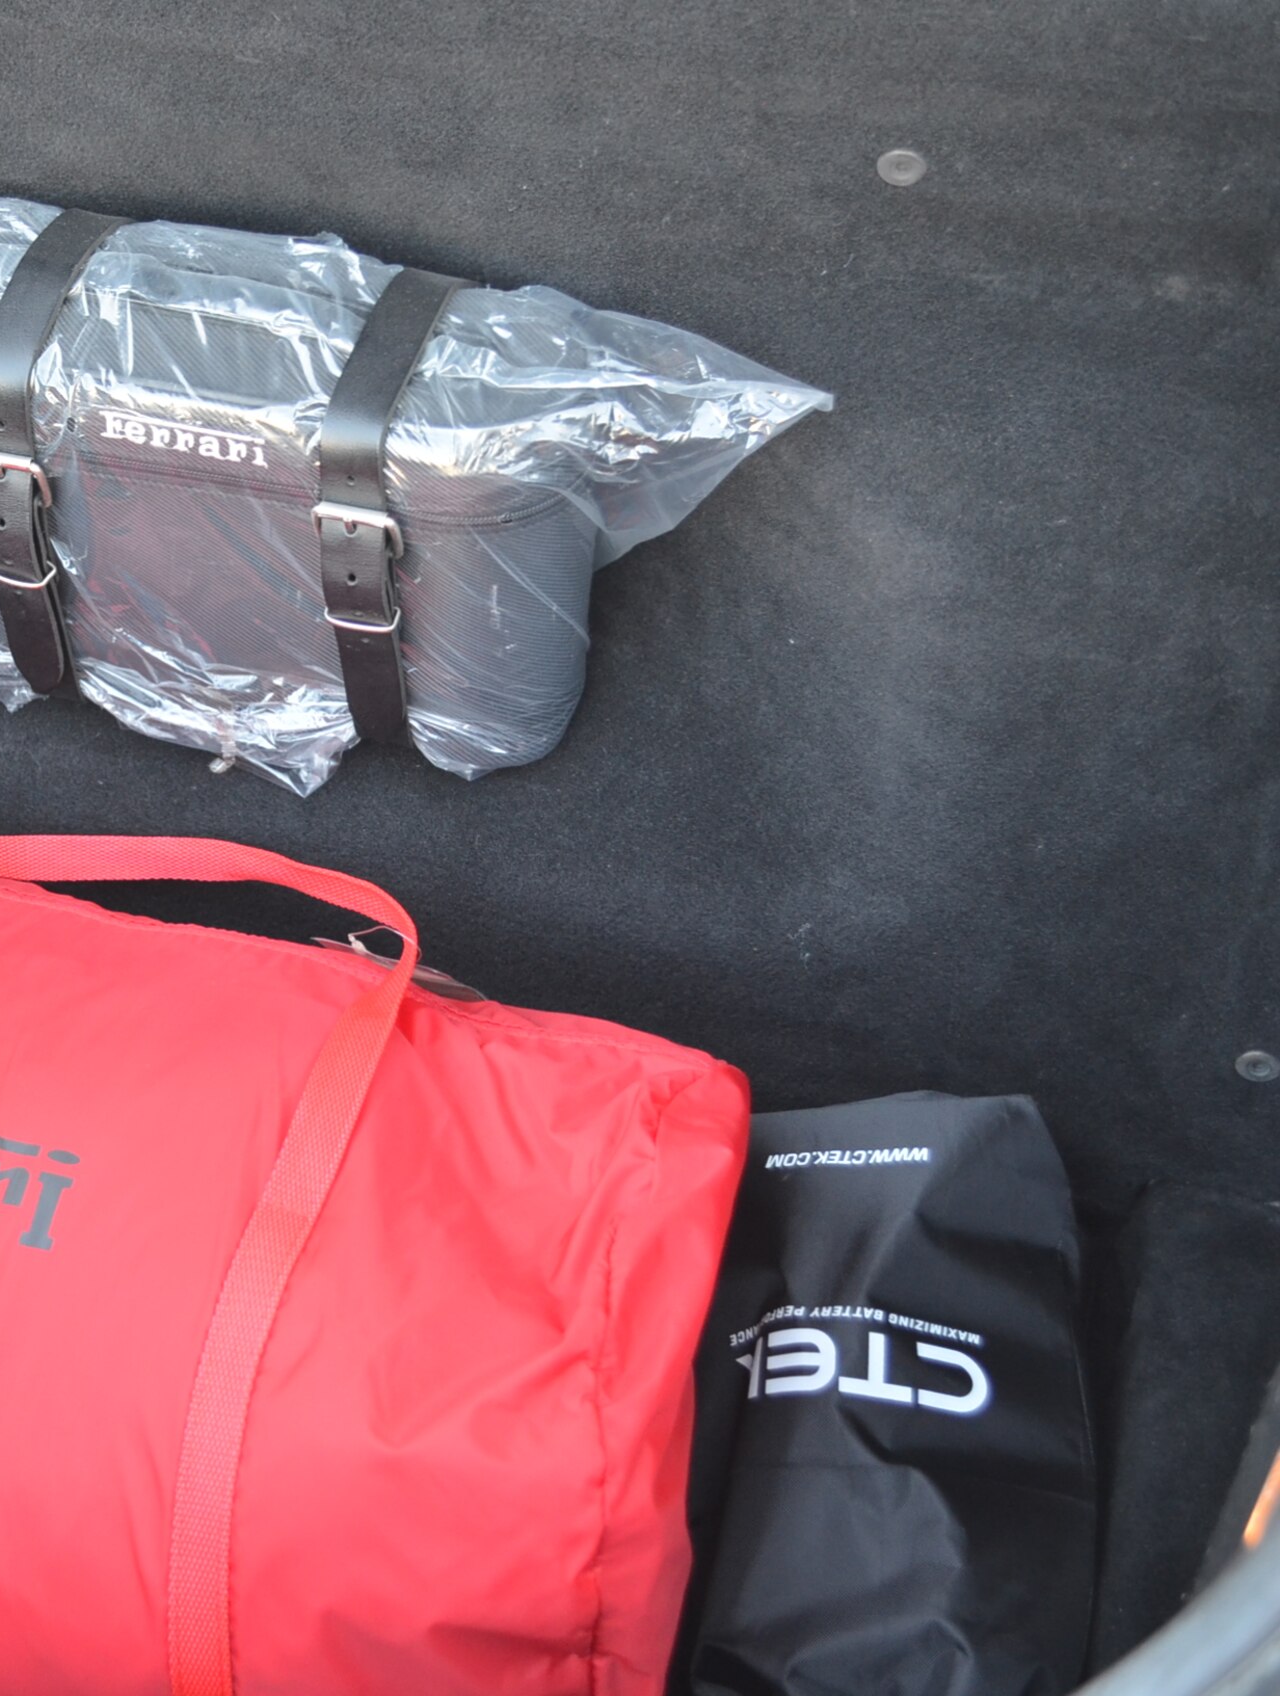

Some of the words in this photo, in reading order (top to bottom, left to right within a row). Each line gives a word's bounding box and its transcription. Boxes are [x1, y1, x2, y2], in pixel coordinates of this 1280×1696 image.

[99, 410, 268, 468] Ferrari
[765, 1147, 929, 1168] WWW.CTEK.COM
[730, 1305, 806, 1346] PERFOANCE
[810, 1305, 884, 1321] BATTERY
[888, 1312, 981, 1345] MAXIMIZING
